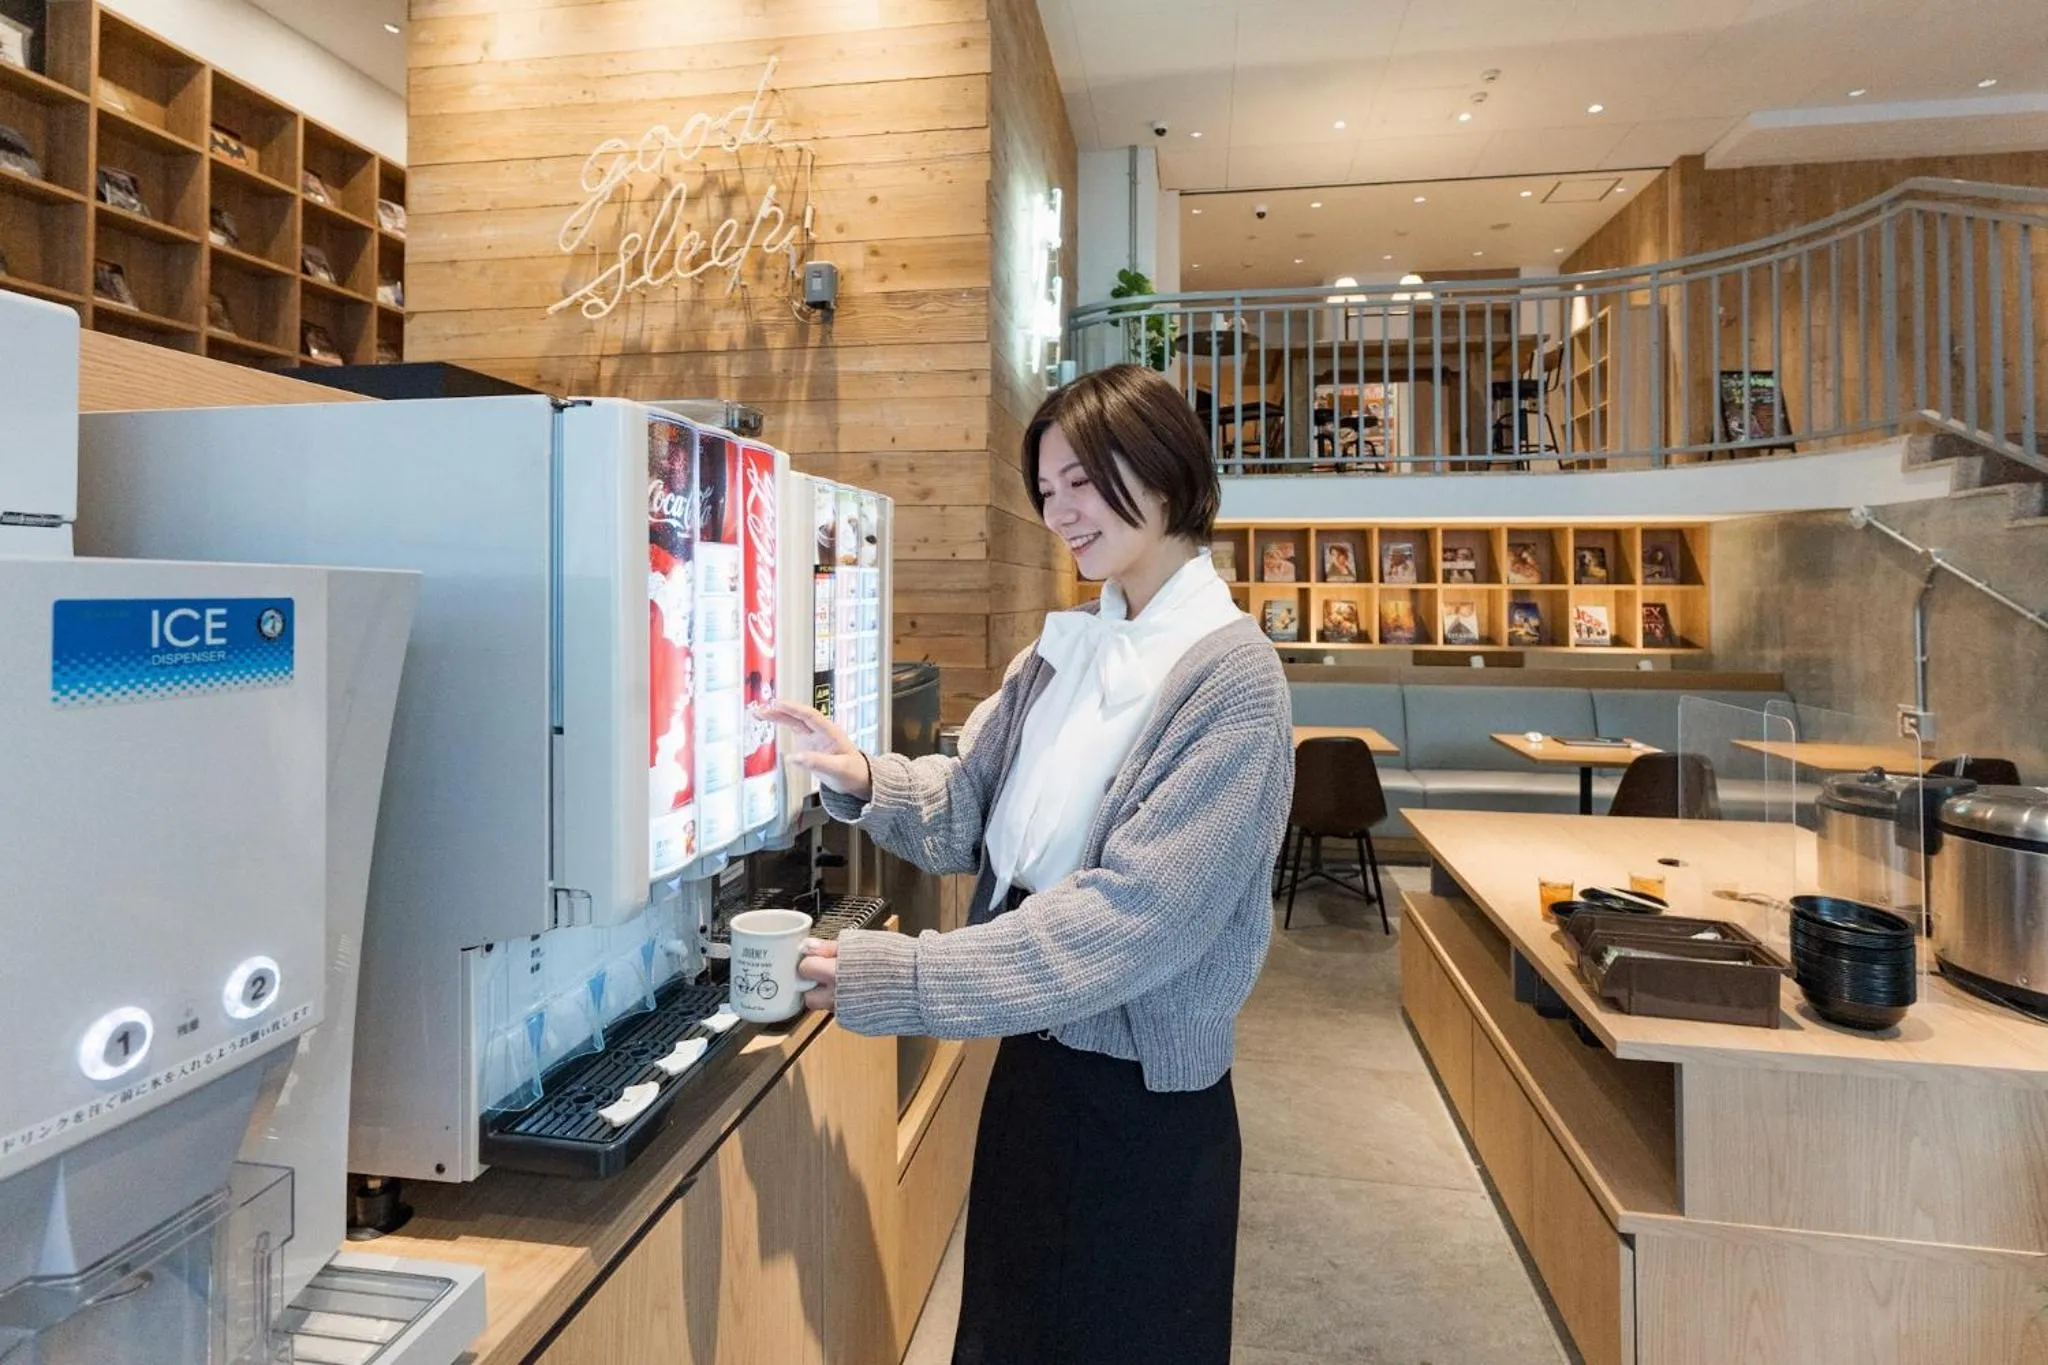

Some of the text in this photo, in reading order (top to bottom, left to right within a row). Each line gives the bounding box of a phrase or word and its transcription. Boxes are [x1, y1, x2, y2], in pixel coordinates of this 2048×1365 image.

[558, 55, 779, 253] good
[547, 182, 798, 319] sleep
[151, 608, 228, 649] ICE
[151, 650, 227, 667] DISPENSER
[251, 975, 267, 1001] 2
[116, 1030, 130, 1056] 1
